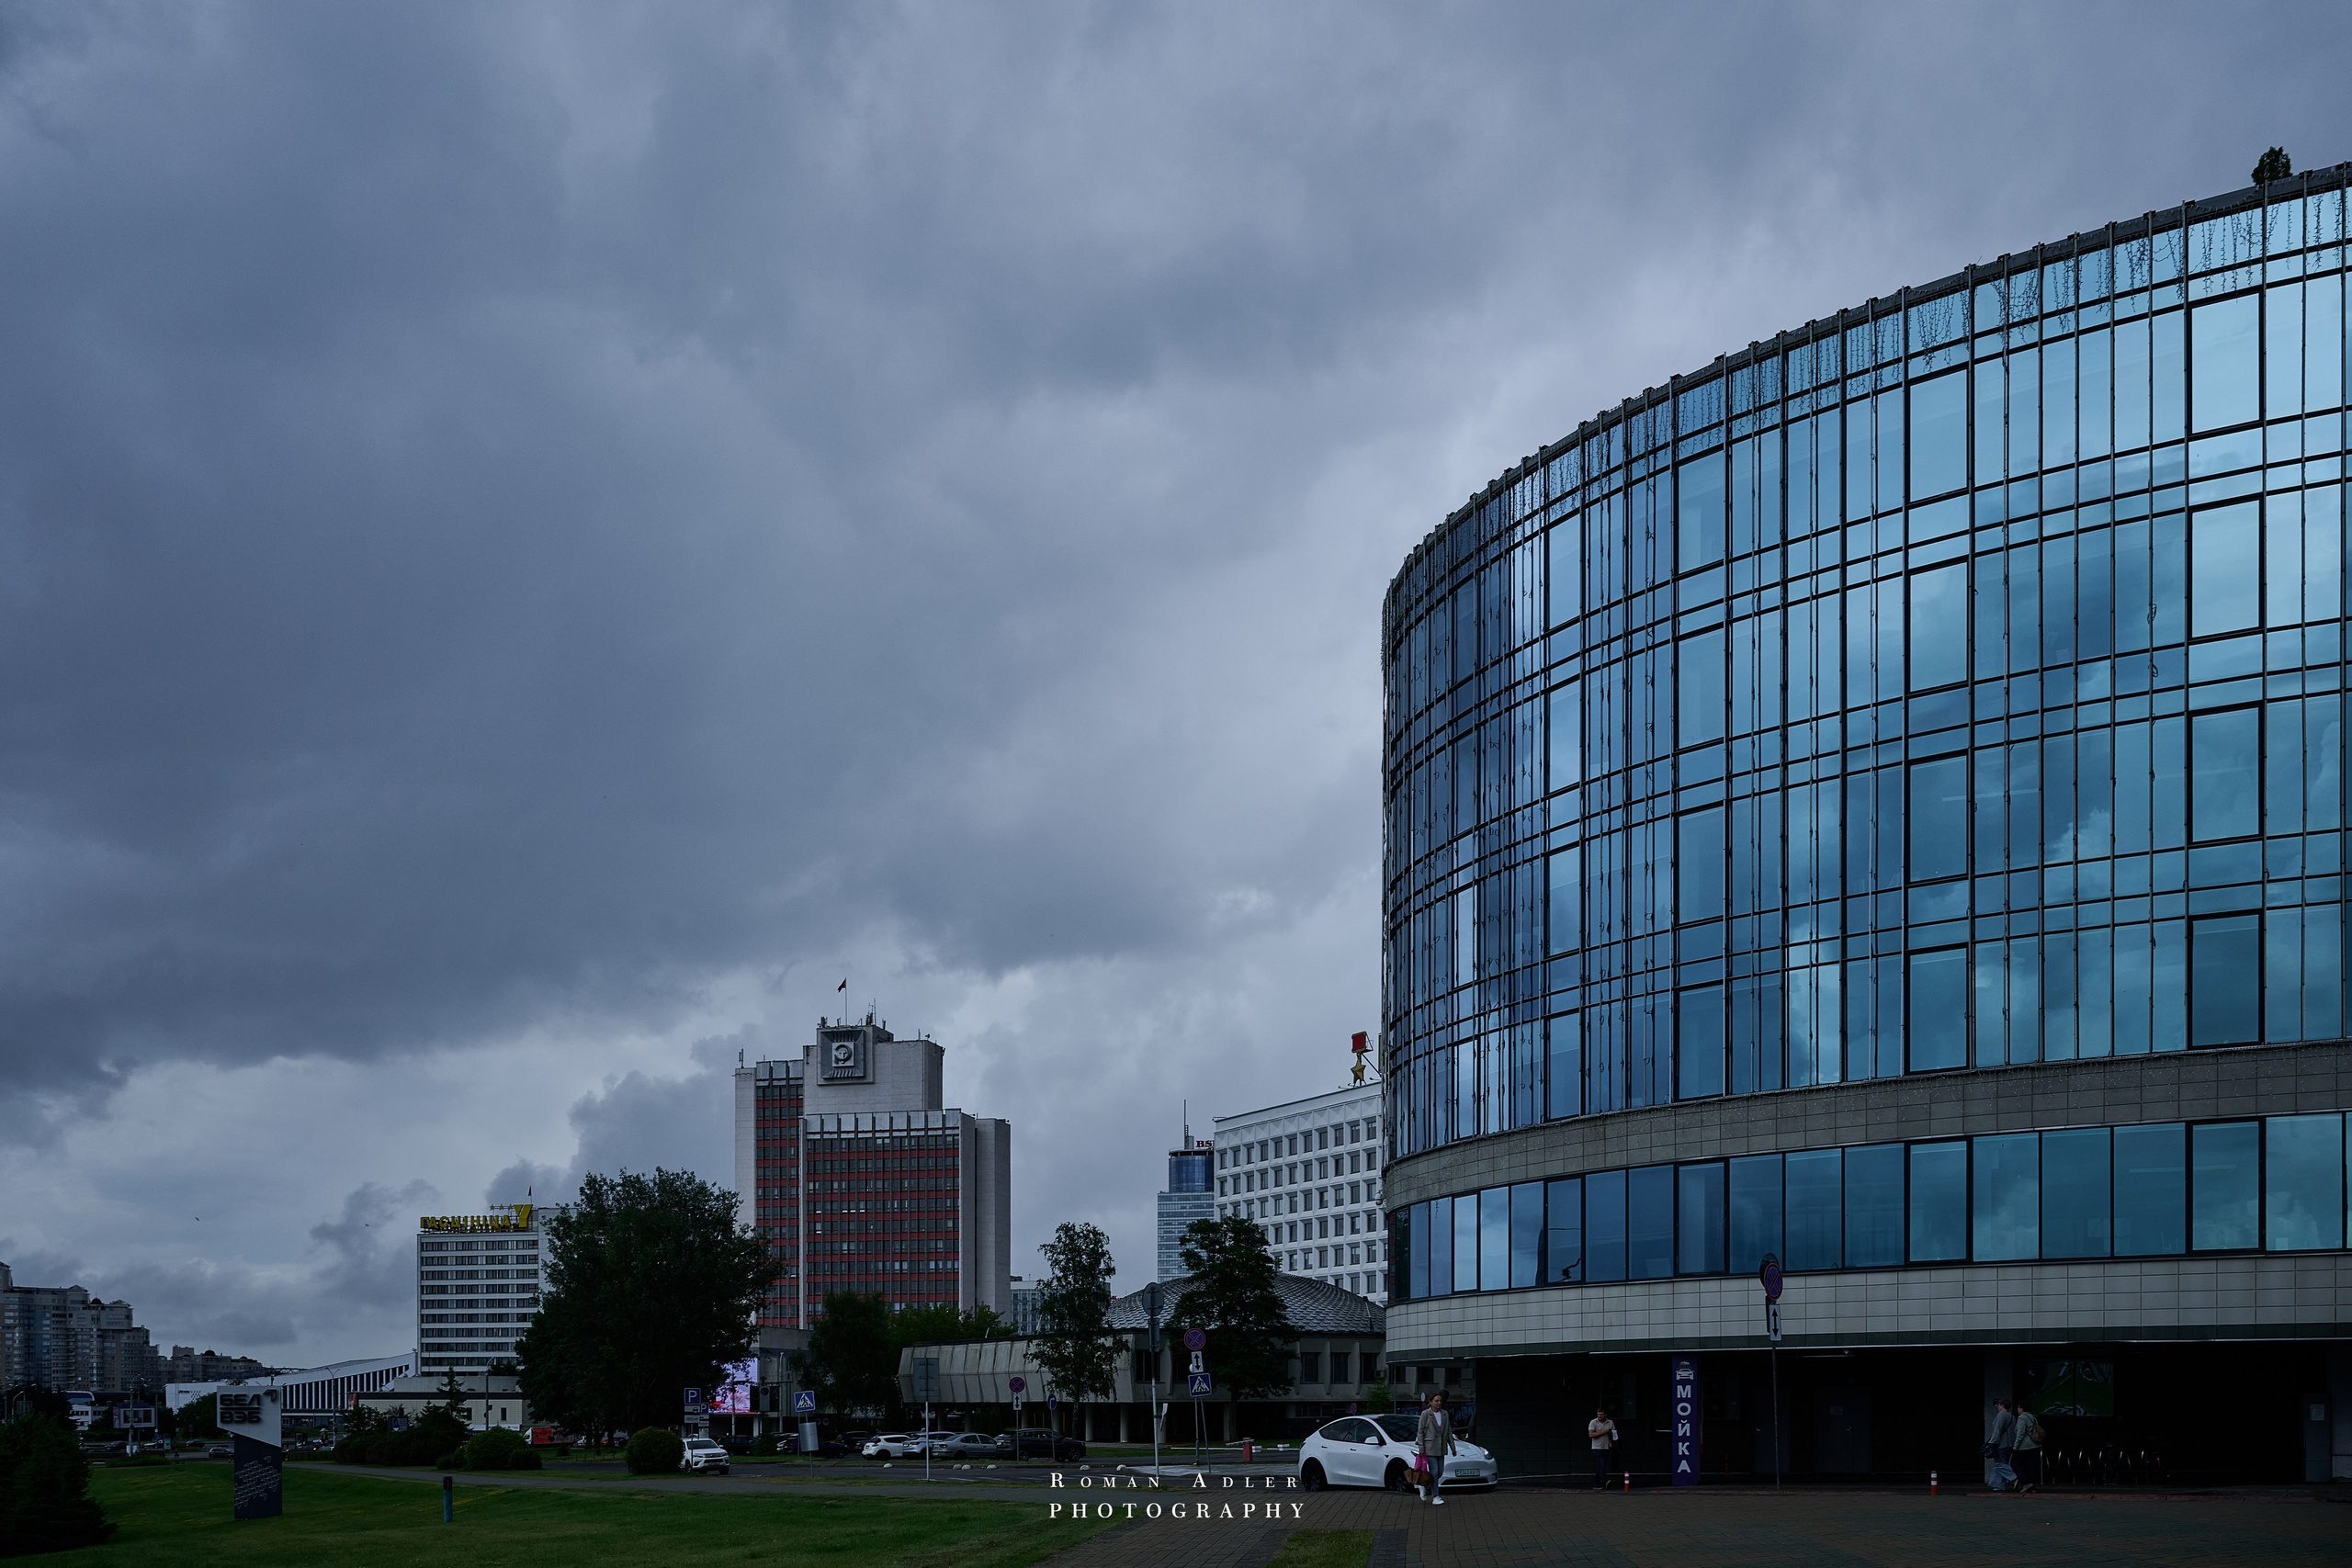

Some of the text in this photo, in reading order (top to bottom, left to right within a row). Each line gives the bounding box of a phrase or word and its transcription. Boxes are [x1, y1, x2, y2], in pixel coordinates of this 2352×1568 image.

[420, 1214, 512, 1229] ГАСЦІНІЦА
[220, 1393, 261, 1406] БЕЛ
[688, 1390, 697, 1403] P
[700, 1404, 707, 1413] P
[220, 1411, 261, 1424] ВЭБ
[1676, 1384, 1691, 1473] МОЙКА
